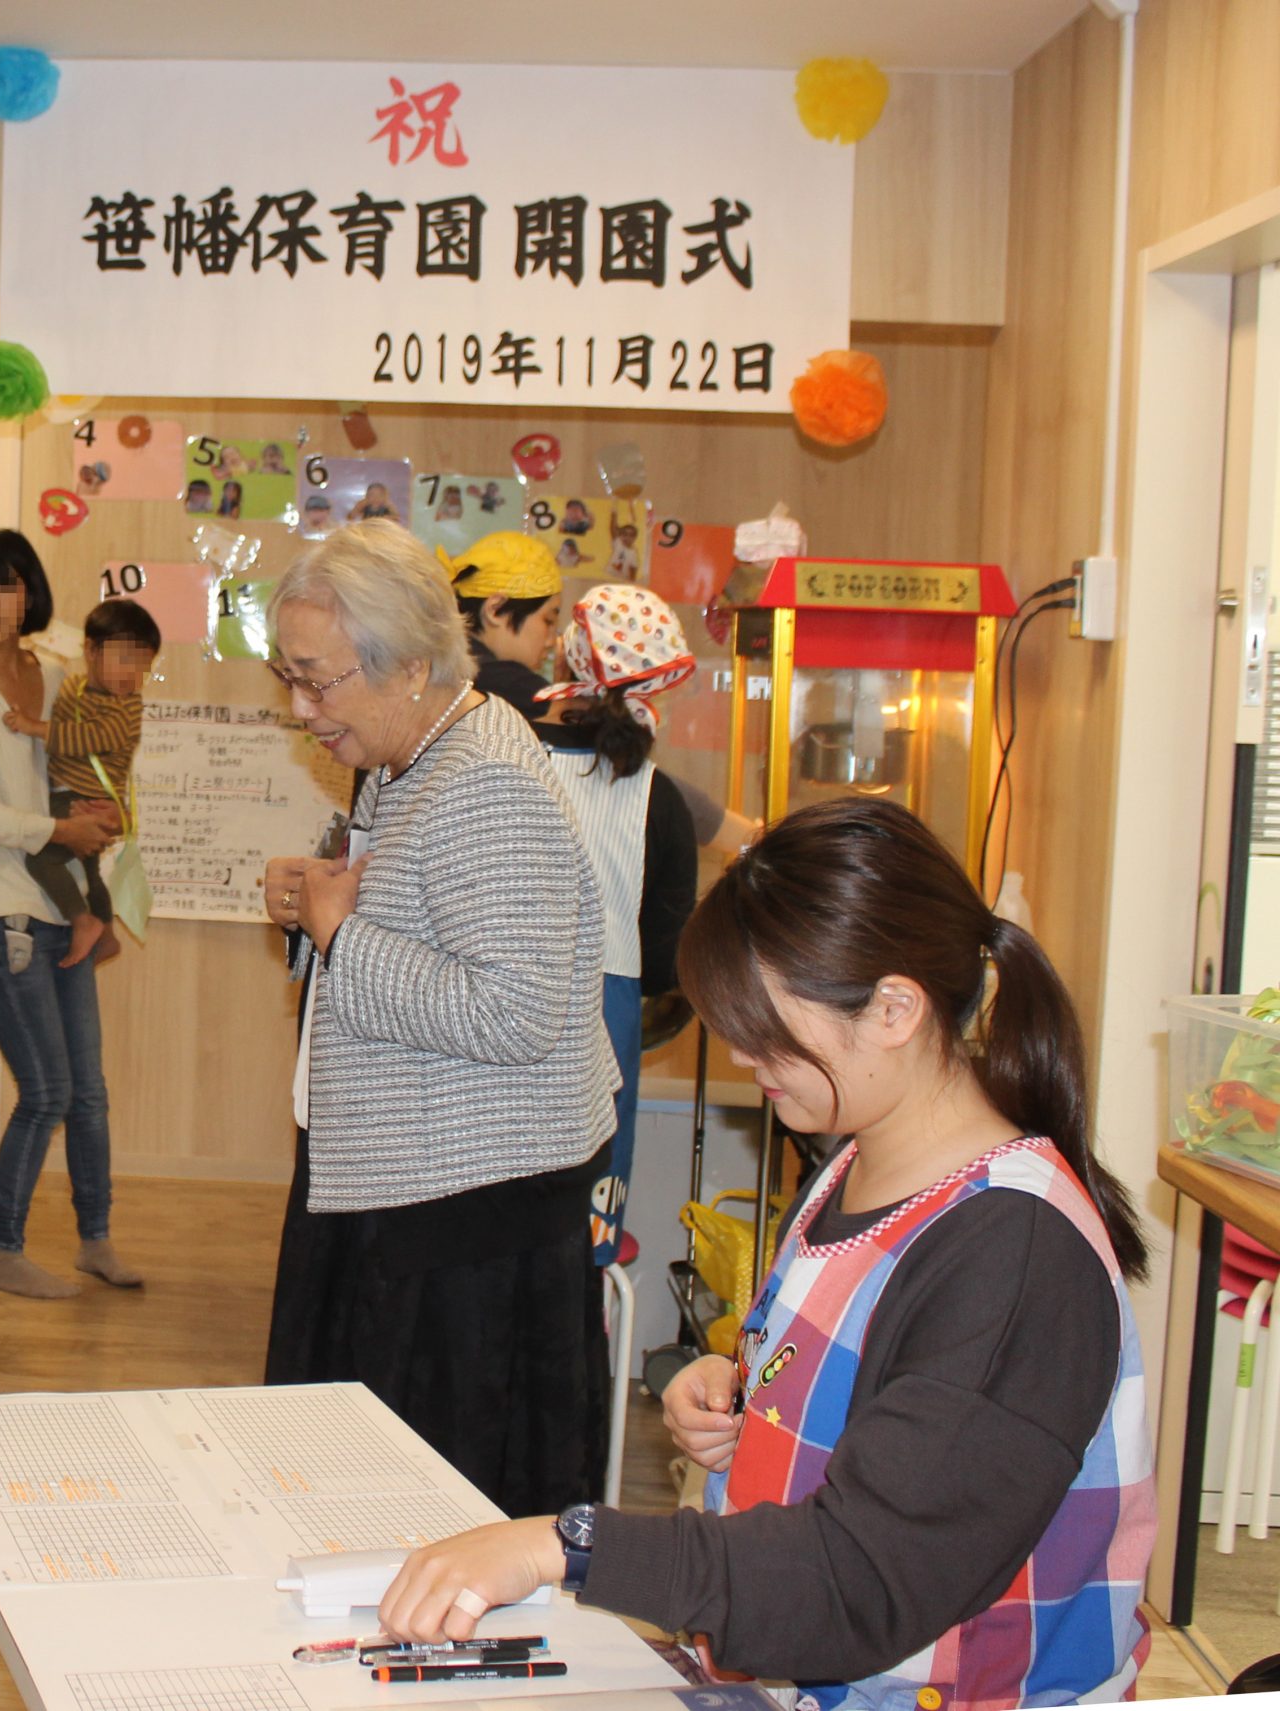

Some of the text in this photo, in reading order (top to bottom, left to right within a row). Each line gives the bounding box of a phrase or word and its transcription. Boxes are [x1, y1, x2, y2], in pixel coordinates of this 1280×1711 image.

[369, 78, 469, 167] 祝
[83, 187, 752, 289] 笹幡保育園 開園式
[374, 332, 773, 392] 2019年11月22日
[74, 420, 96, 447] 4
[193, 437, 220, 466] 5
[305, 456, 329, 486] 6
[420, 475, 440, 506] 7
[530, 501, 556, 530] 8
[657, 520, 683, 548] 9
[101, 565, 143, 598] 10
